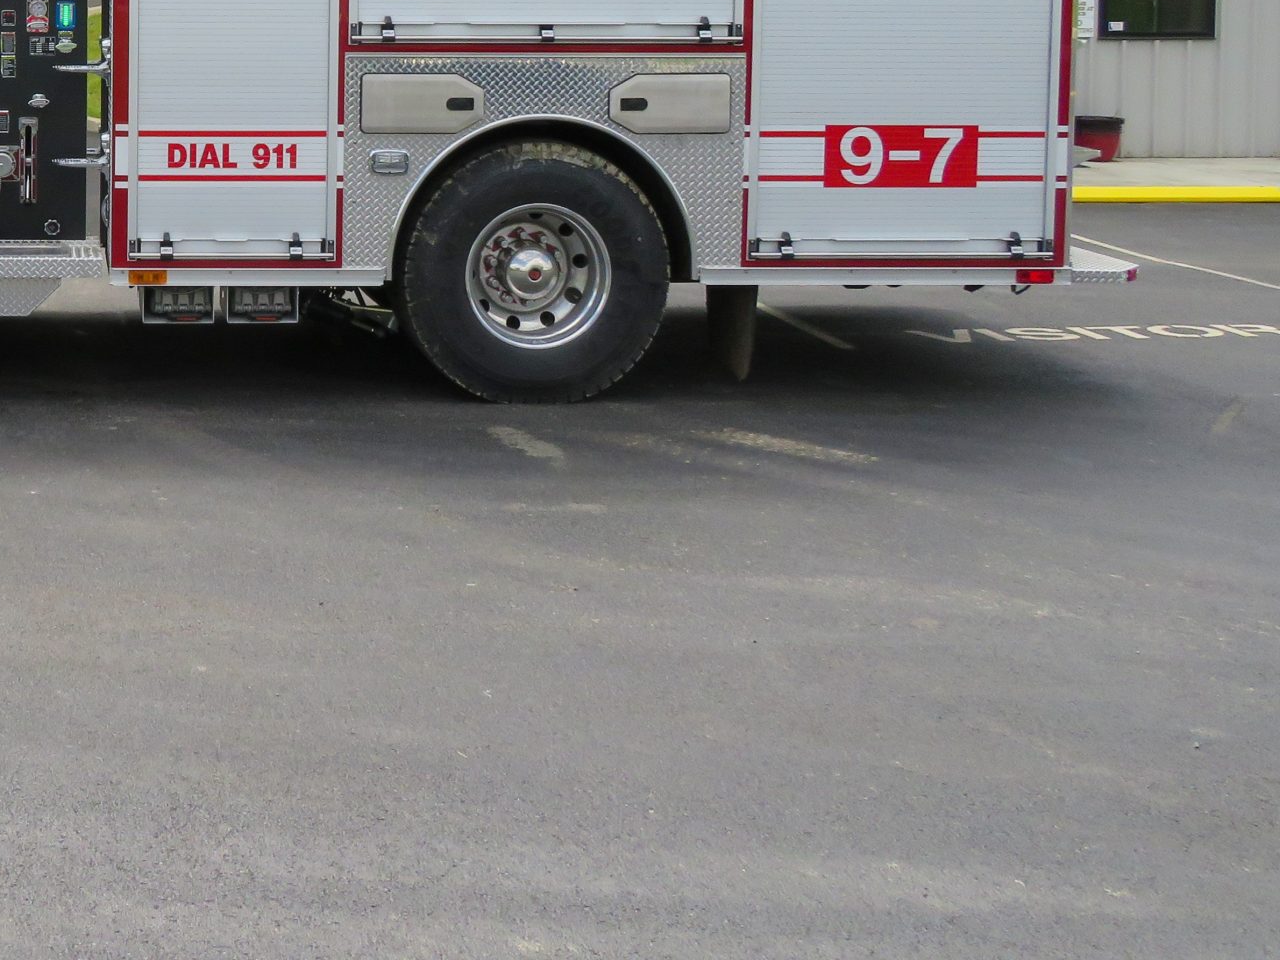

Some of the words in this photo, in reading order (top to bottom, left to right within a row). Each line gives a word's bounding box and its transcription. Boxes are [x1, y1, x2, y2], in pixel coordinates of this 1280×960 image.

[167, 143, 237, 169] DIAL
[252, 143, 298, 169] 911
[839, 127, 965, 184] 9-7
[904, 324, 1280, 343] VISITOR
